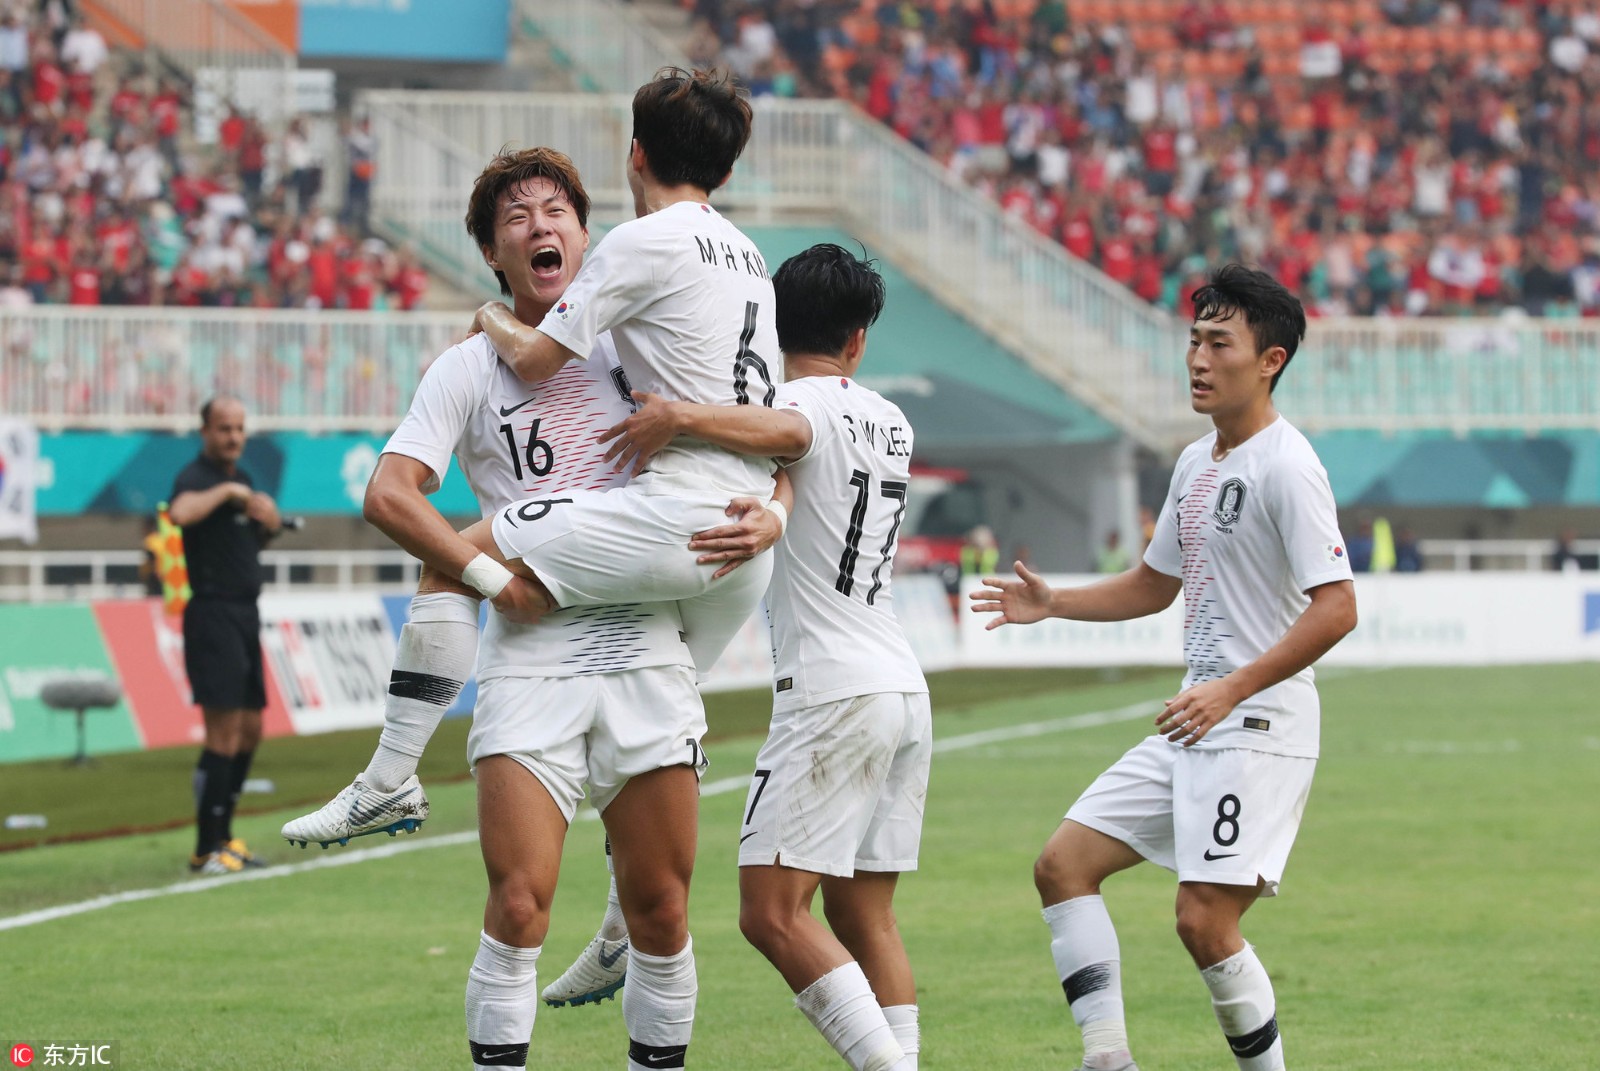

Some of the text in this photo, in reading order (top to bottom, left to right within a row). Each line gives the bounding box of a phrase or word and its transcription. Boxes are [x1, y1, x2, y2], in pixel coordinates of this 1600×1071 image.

[694, 236, 717, 266] M
[720, 241, 738, 271] H
[733, 301, 775, 405] 6
[499, 418, 554, 481] 16
[843, 415, 909, 456] S W LEE
[835, 468, 907, 605] 17
[745, 769, 771, 825] 7
[1213, 793, 1241, 847] 8
